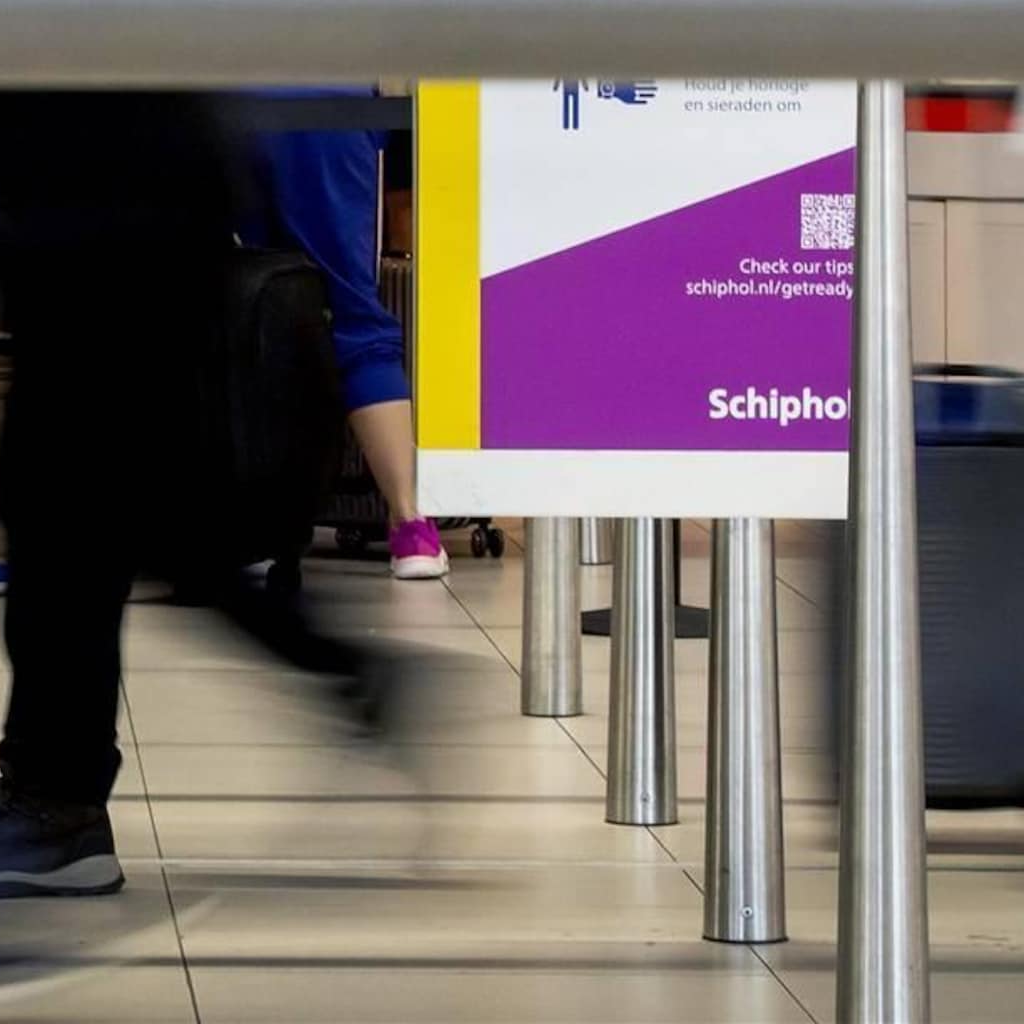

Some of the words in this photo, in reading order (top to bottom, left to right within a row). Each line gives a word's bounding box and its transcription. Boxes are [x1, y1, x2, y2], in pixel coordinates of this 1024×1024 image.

[683, 101, 704, 112] en
[707, 98, 773, 113] sieraden
[776, 101, 802, 113] om
[738, 257, 790, 275] Check
[791, 262, 822, 275] our
[824, 259, 854, 276] tips
[685, 279, 853, 300] schiphol.nl/getready
